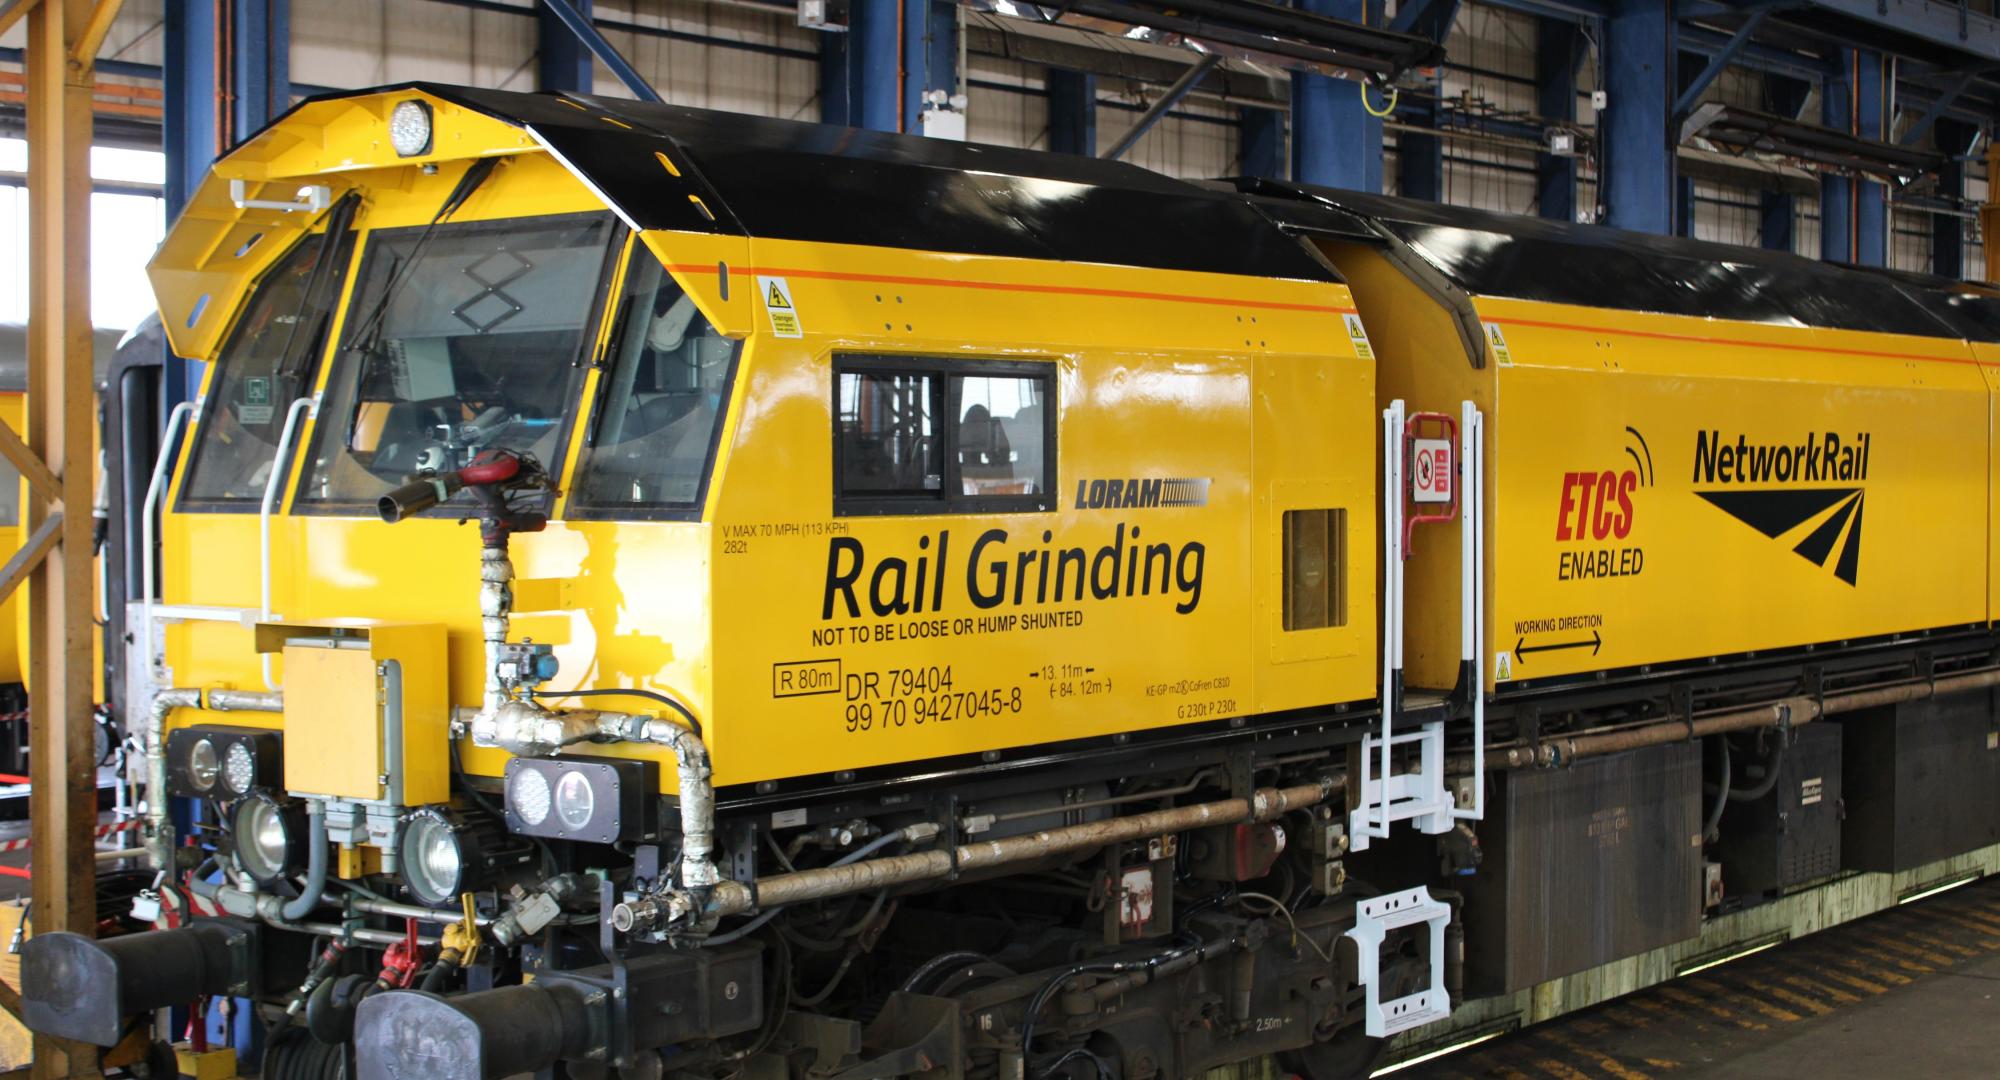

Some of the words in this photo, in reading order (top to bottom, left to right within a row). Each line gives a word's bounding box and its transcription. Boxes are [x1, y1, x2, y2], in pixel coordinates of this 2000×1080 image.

[1075, 478, 1163, 509] LORAM
[1556, 470, 1637, 542] ETCS
[722, 526, 730, 538] V
[733, 525, 757, 537] MAX
[760, 524, 773, 537] 70
[775, 523, 799, 536] MPH
[802, 522, 823, 537] (113
[825, 521, 849, 536] KPH)
[724, 540, 748, 554] 282t
[821, 530, 950, 620] Rail
[966, 522, 1206, 615] Grinding
[1558, 548, 1644, 581] ENABLED
[812, 628, 845, 647] NOT
[849, 626, 870, 644] TO
[875, 624, 895, 642] BE
[899, 619, 949, 641] LOOSE
[953, 618, 974, 636] OR
[978, 615, 1017, 633] HUMP
[1021, 611, 1083, 630] SHUNTED
[1515, 618, 1556, 635] WORKING
[1559, 614, 1602, 631] DIRECTION
[781, 671, 793, 690] R
[799, 669, 833, 689] 80m
[846, 672, 880, 702] DR
[888, 665, 953, 697] 79404
[846, 703, 872, 733] 99
[880, 699, 906, 728] 70
[914, 686, 1022, 725] 9427045-8
[1177, 706, 1185, 719] G
[1187, 703, 1207, 718] 230t
[1209, 702, 1215, 714] P
[1216, 699, 1237, 714] 230t
[1256, 1017, 1282, 1032] 2.50m
